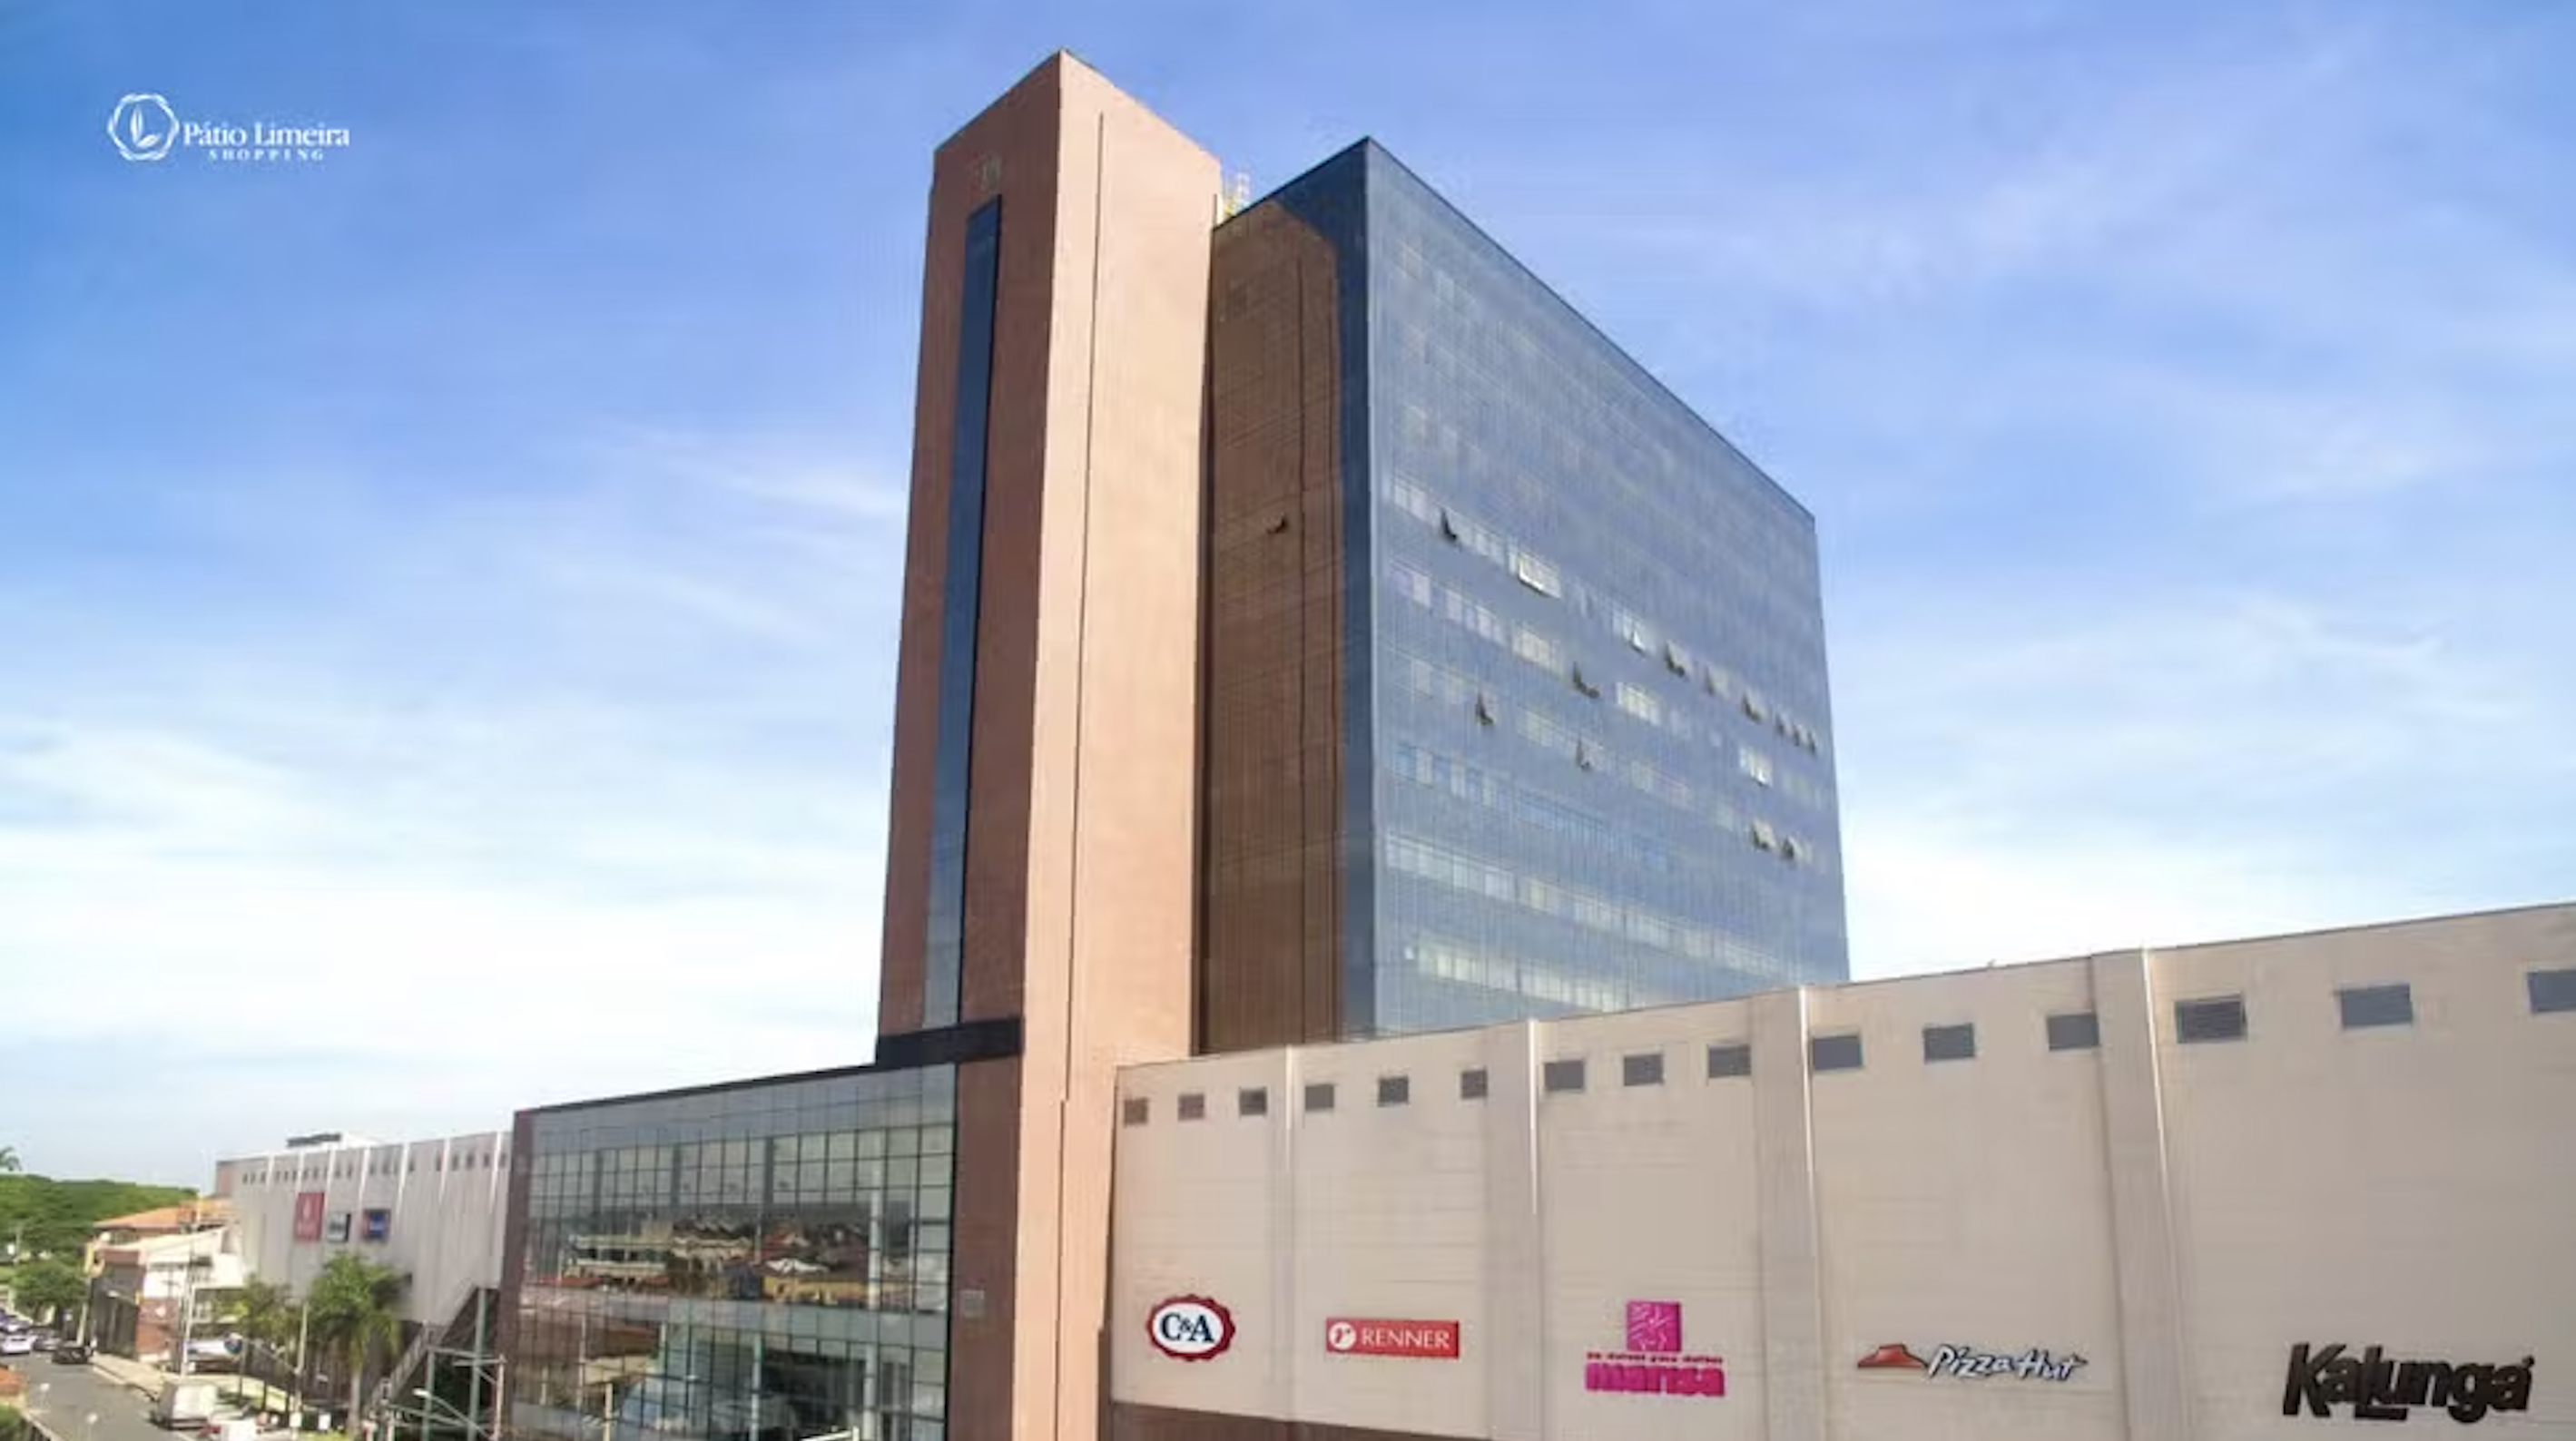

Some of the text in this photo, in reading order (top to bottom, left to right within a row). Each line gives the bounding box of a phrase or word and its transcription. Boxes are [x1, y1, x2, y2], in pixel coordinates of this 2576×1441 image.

[1161, 1312, 1214, 1343] C&A
[1362, 1326, 1450, 1349] RENNER
[1927, 1344, 2089, 1380] Pizza Hut
